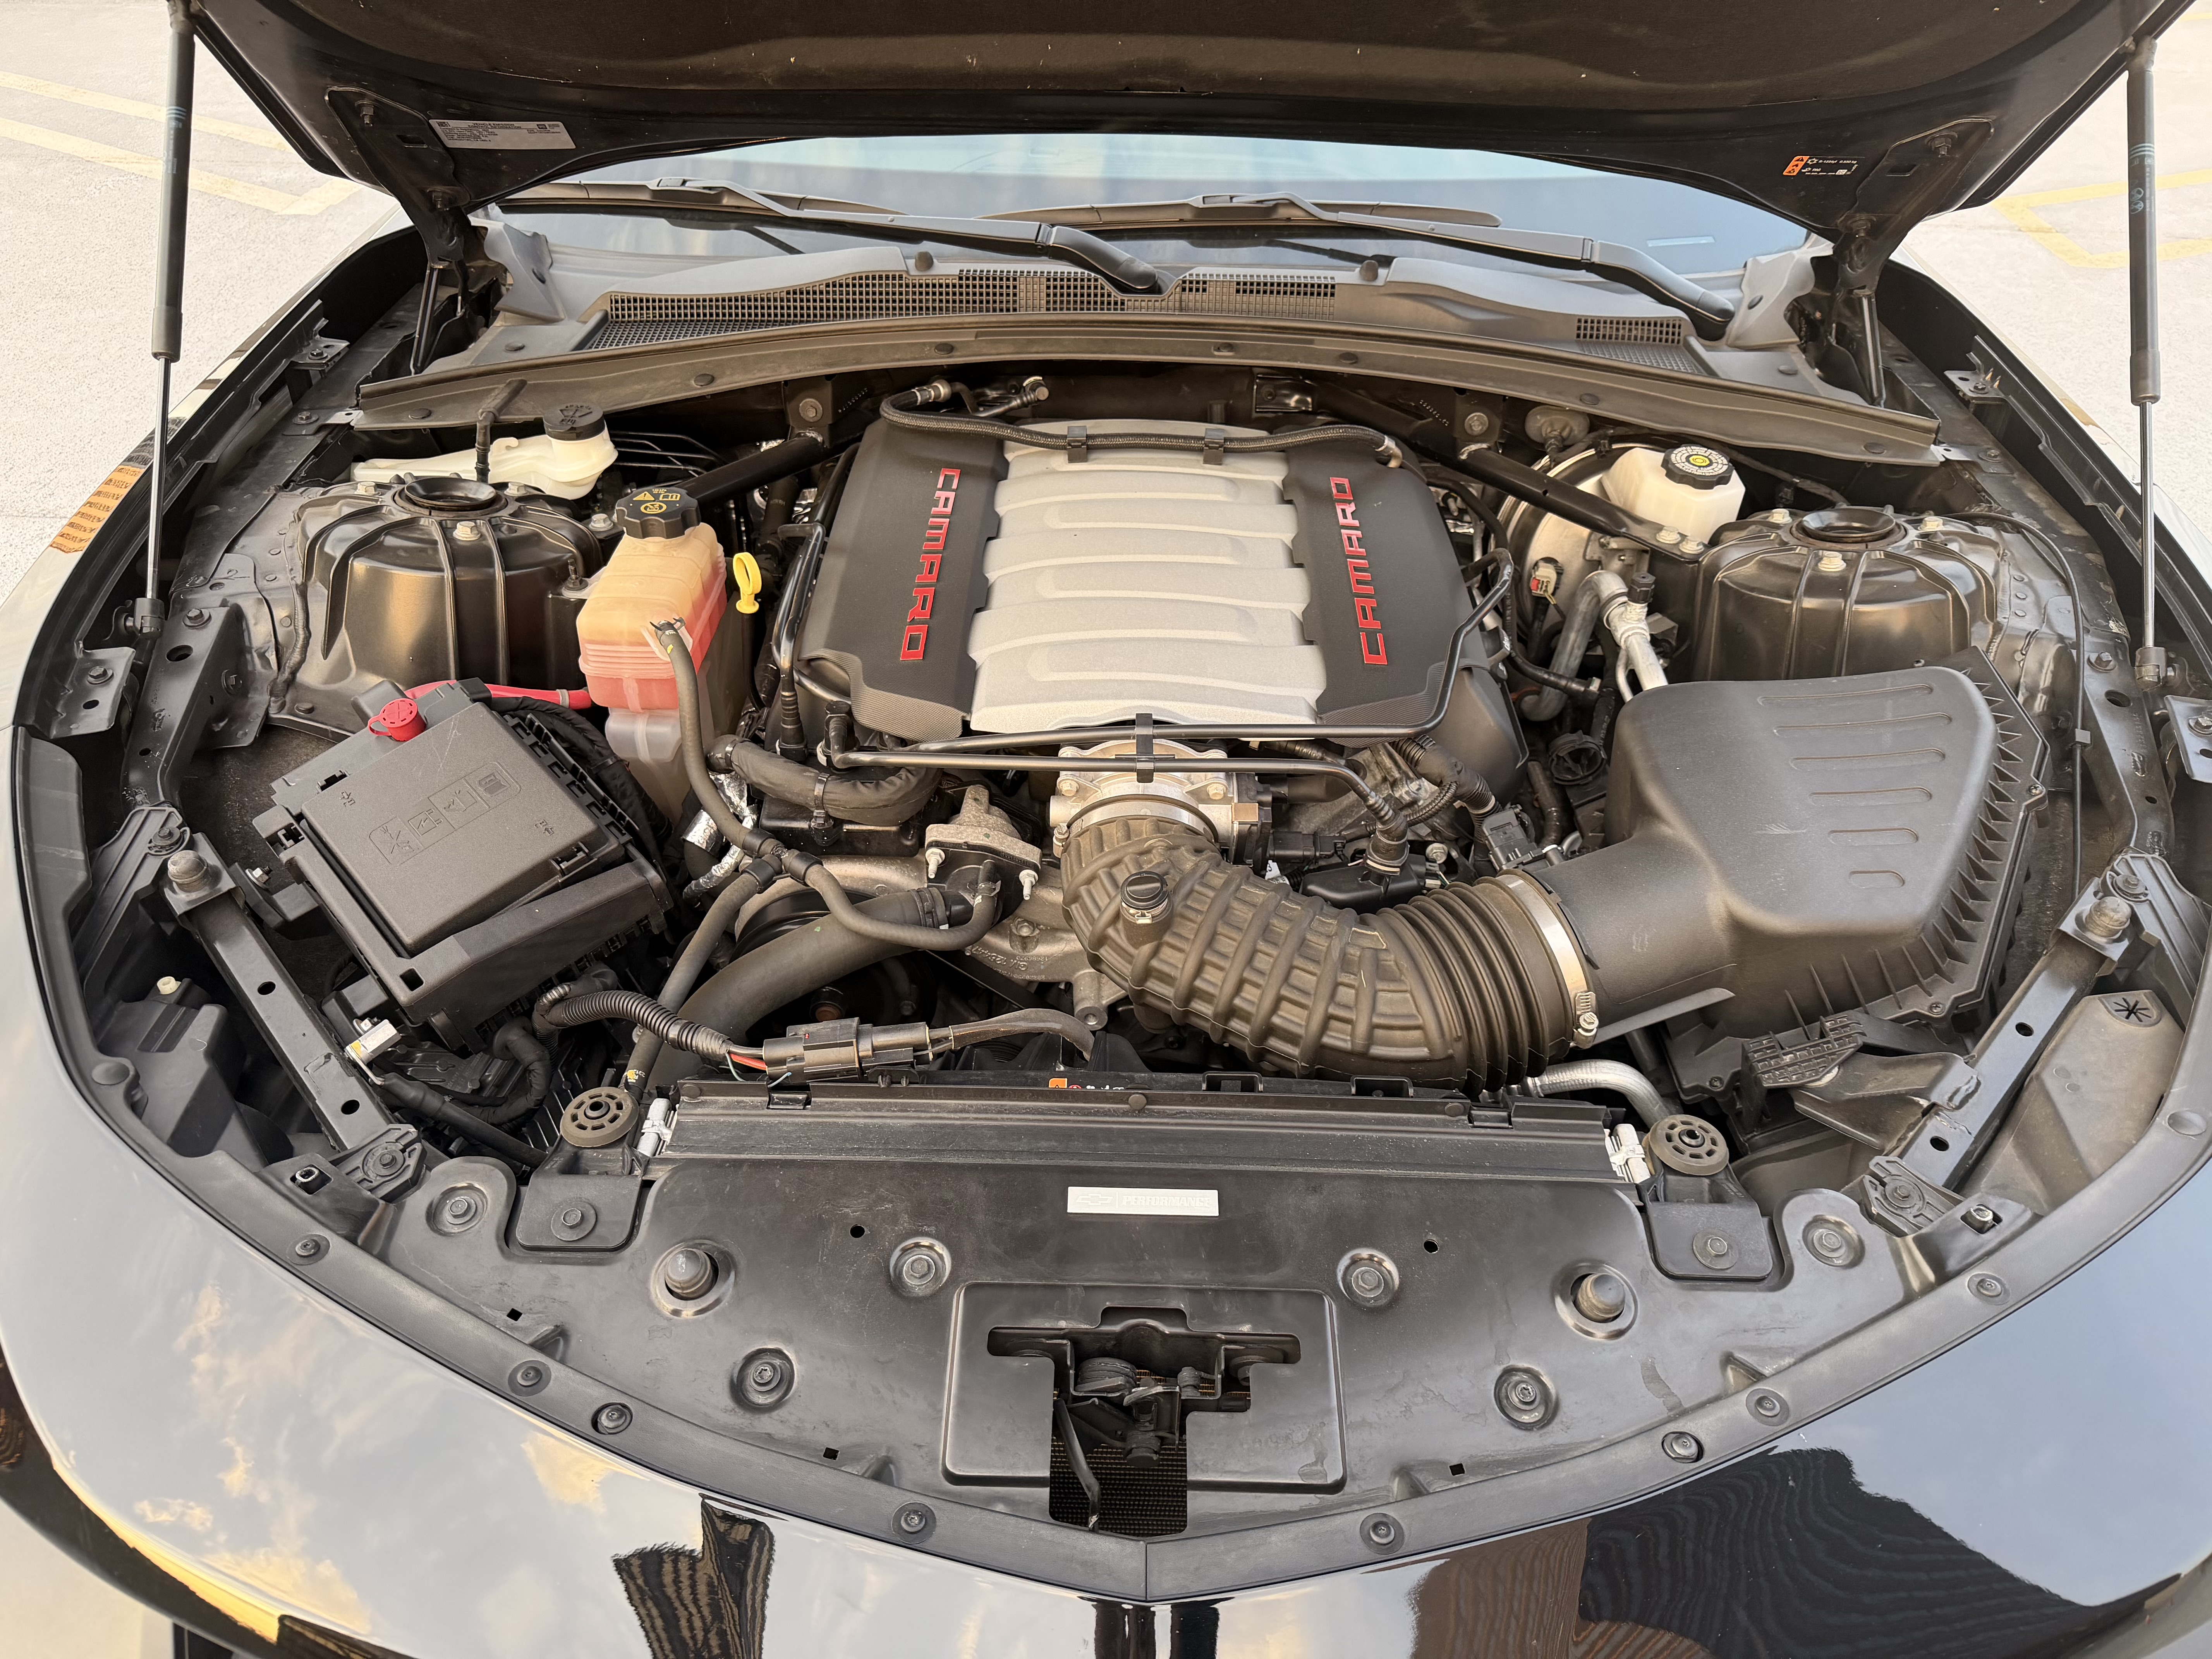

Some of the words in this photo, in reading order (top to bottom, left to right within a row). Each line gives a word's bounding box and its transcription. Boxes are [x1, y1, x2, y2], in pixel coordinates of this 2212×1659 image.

[900, 468, 961, 660] CAMARO
[1330, 477, 1388, 665] CAMARO
[1122, 1195, 1210, 1208] PERFORMANCE
